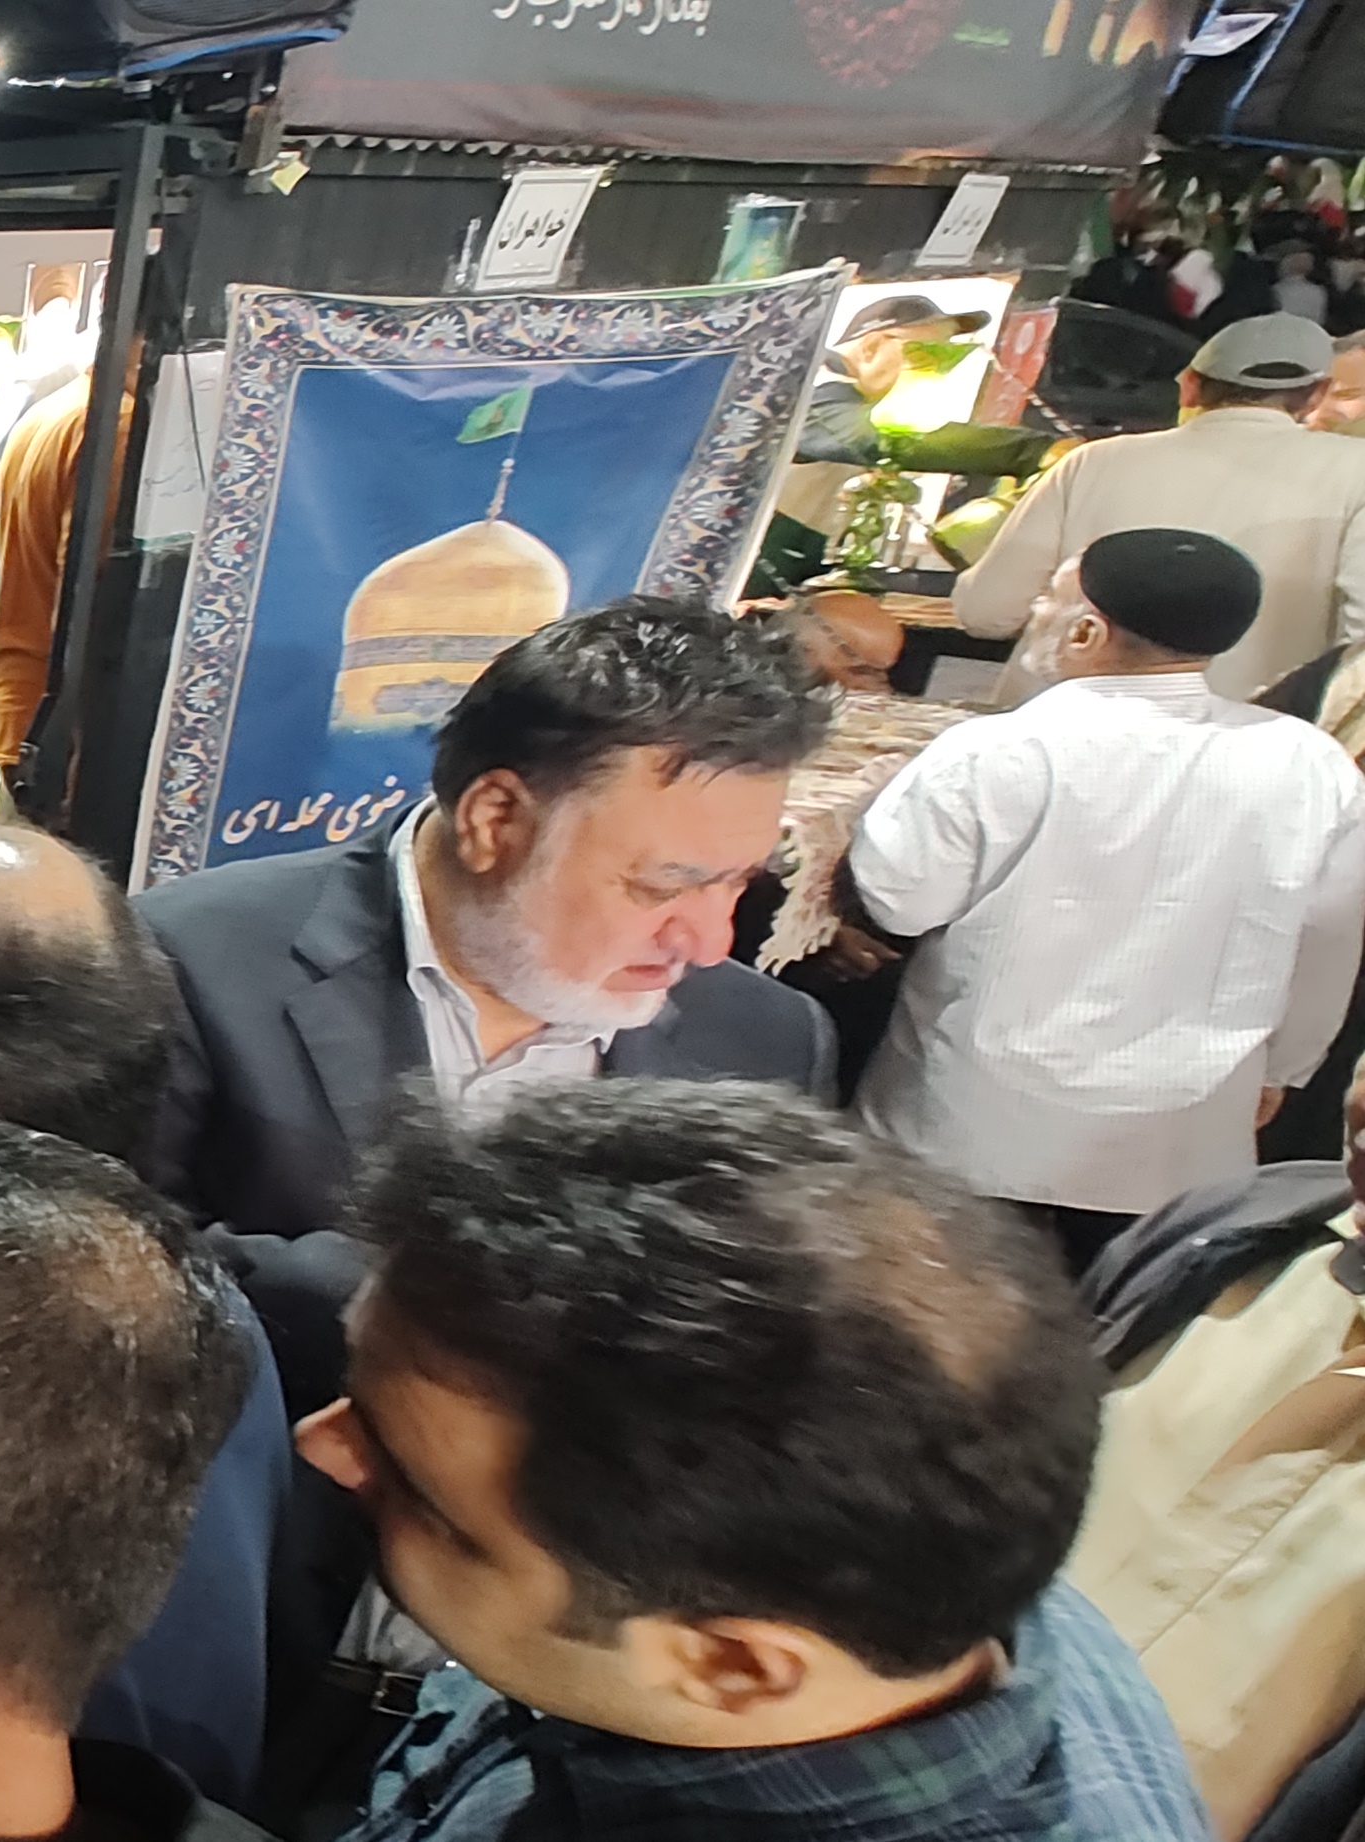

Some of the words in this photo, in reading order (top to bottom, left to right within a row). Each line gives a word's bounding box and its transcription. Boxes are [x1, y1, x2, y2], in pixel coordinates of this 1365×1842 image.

[498, 209, 569, 250] خواهران
[222, 799, 281, 844] ای
[326, 774, 406, 842] ضوی
